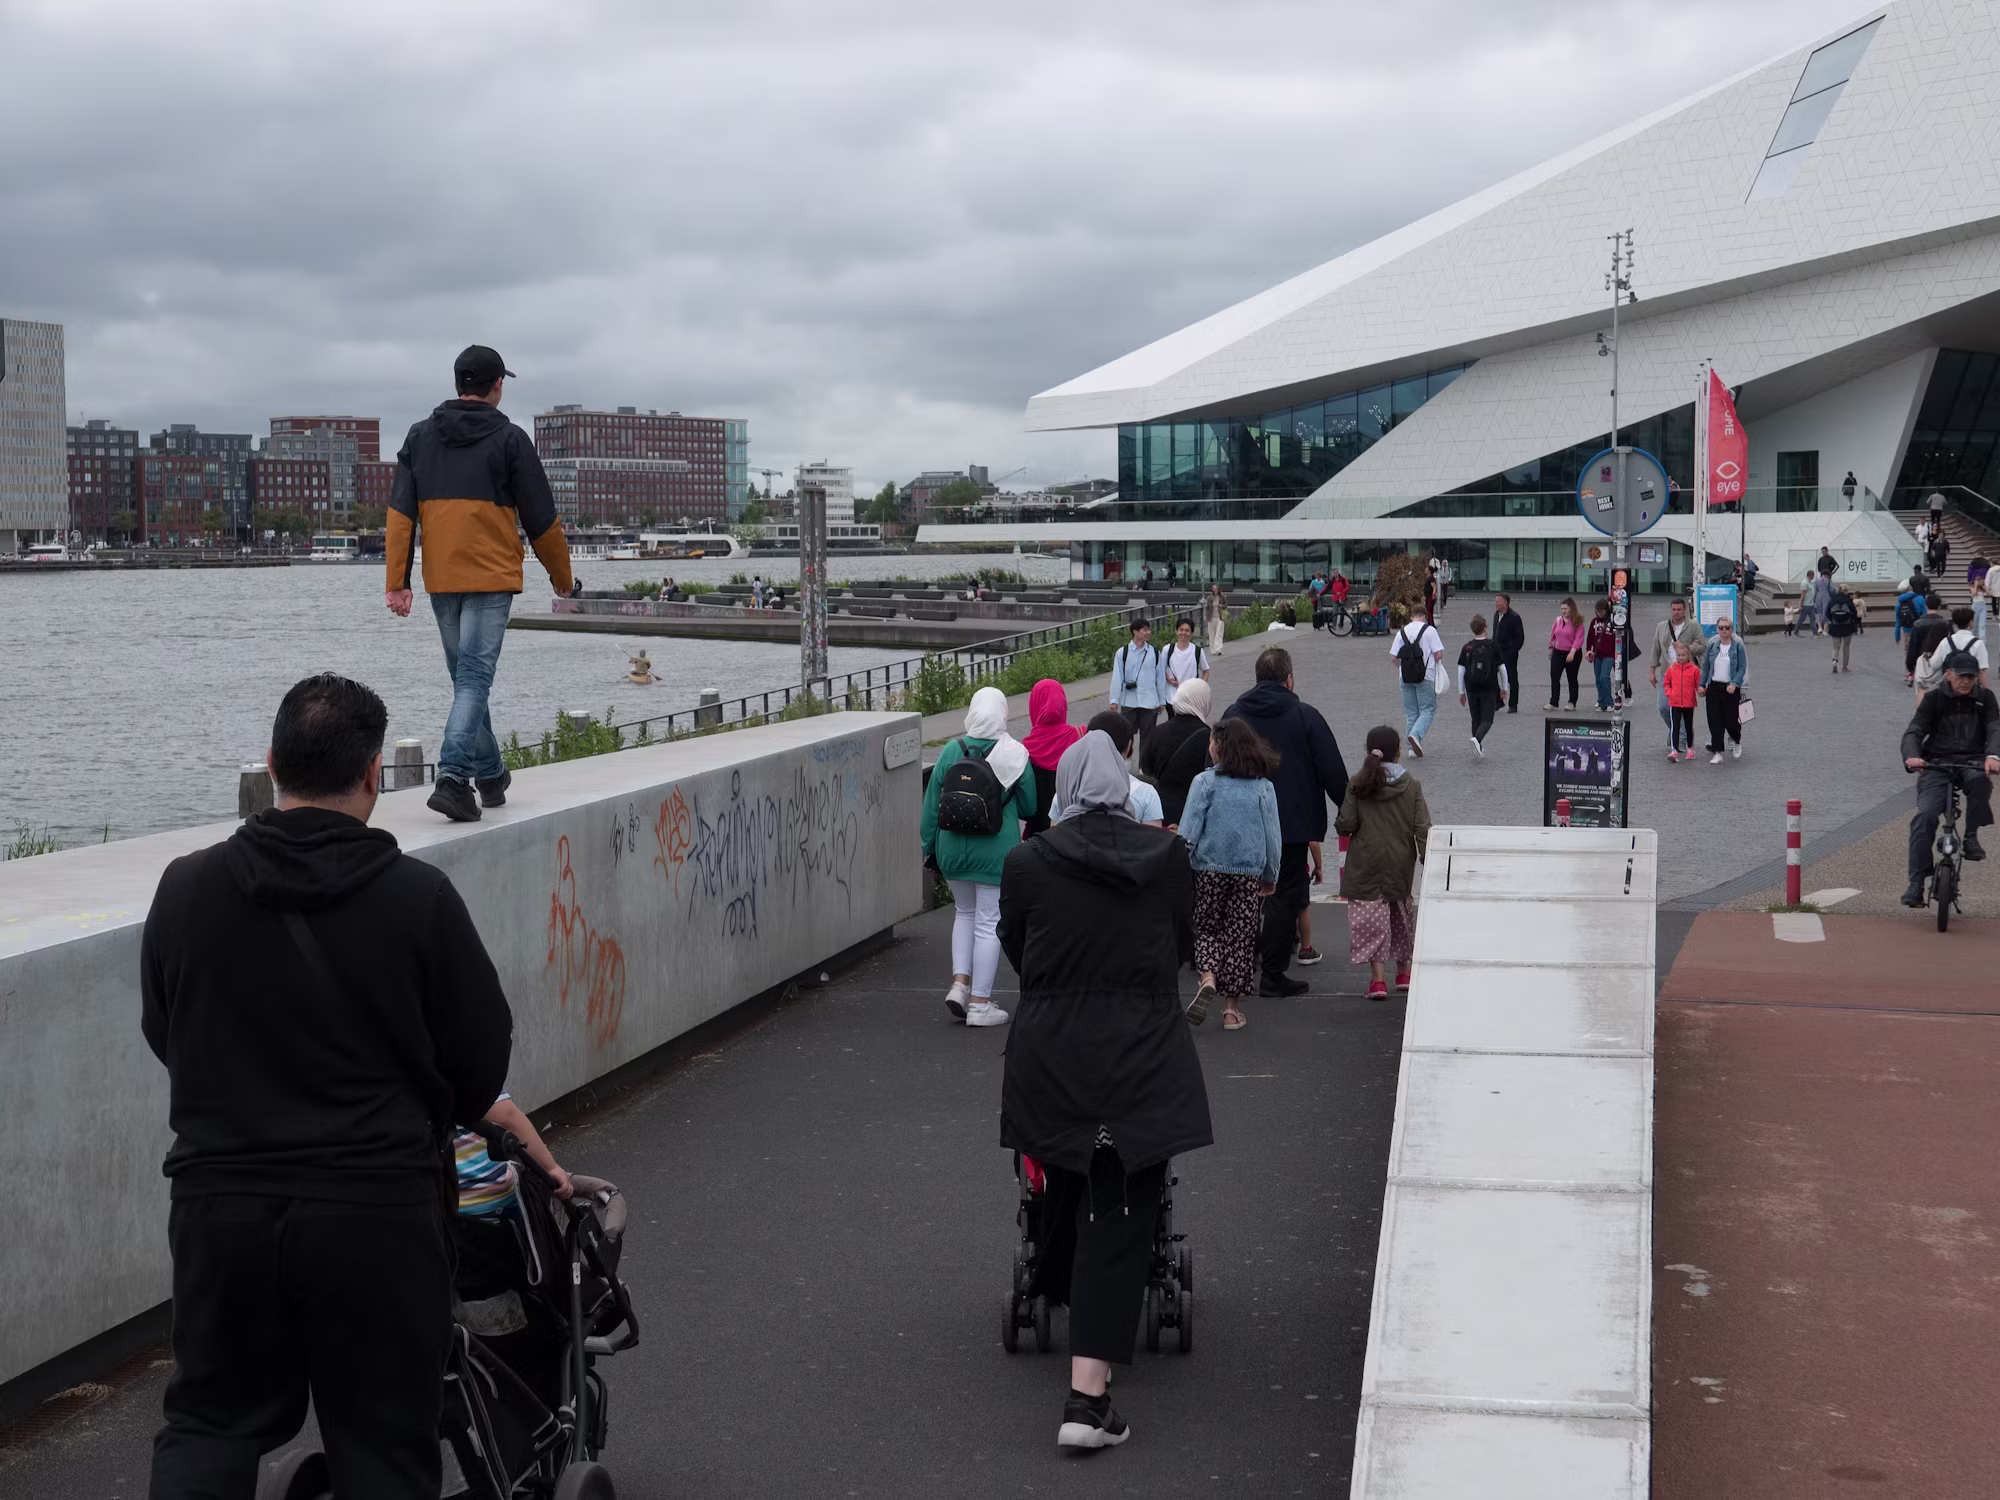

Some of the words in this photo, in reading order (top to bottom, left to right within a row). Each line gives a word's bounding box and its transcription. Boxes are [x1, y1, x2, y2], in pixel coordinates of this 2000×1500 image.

[1717, 481, 1740, 495] eye
[1597, 496, 1610, 504] BEST
[1848, 560, 1867, 574] eye
